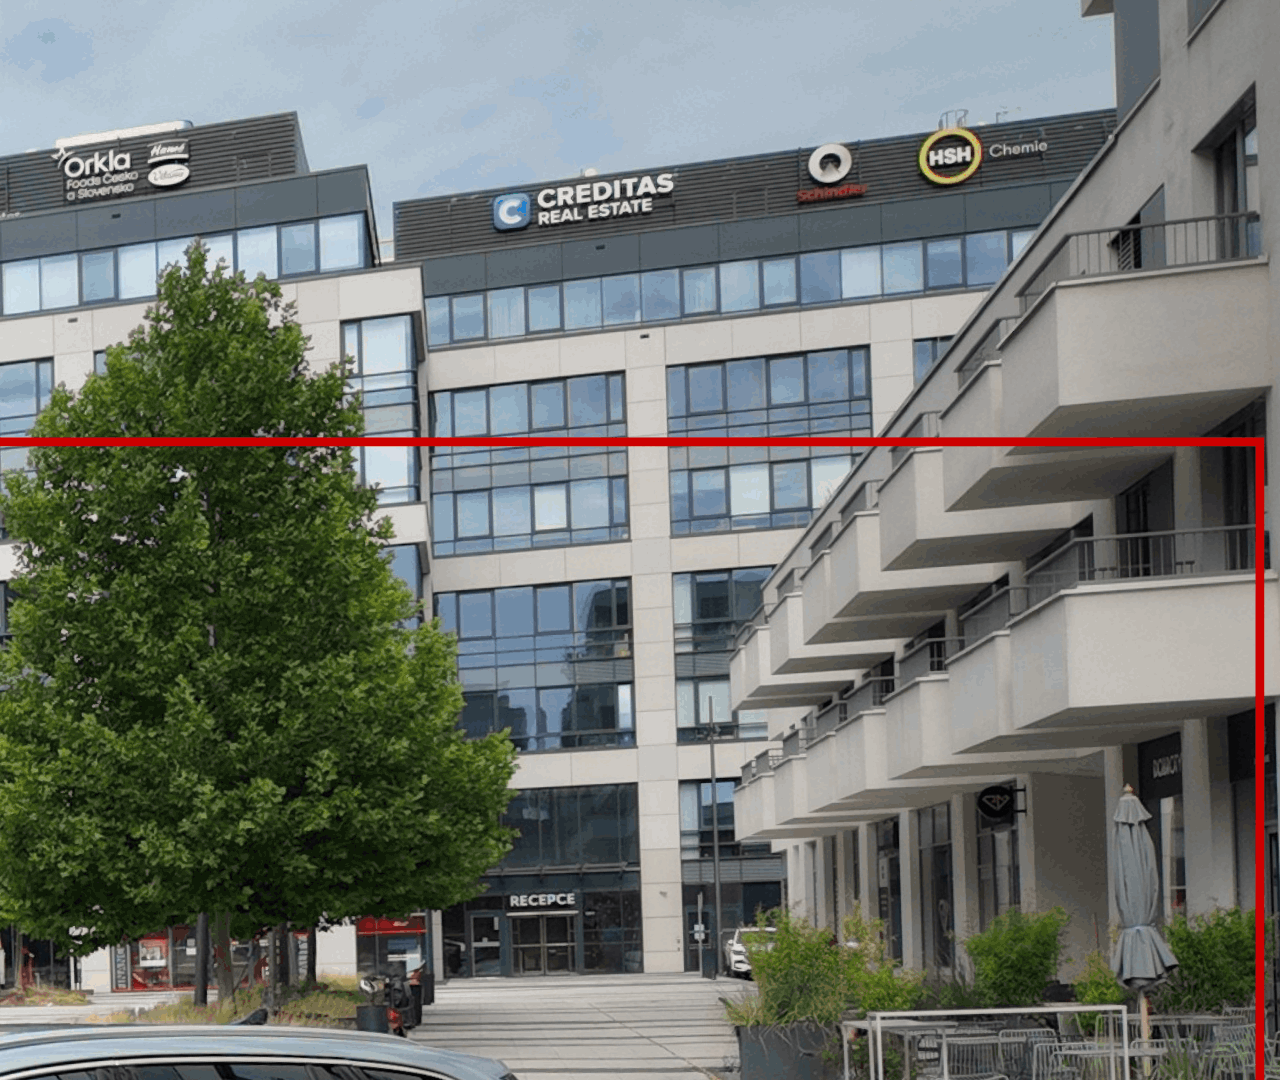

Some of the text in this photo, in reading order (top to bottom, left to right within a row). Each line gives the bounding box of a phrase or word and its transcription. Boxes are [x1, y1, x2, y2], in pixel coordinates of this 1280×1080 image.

[64, 149, 131, 178] Orkla
[929, 140, 1048, 168] HSH Chemie
[537, 173, 674, 208] CREDITAS
[537, 197, 653, 226] REAL ESTATE
[509, 892, 576, 908] RECEPCE
